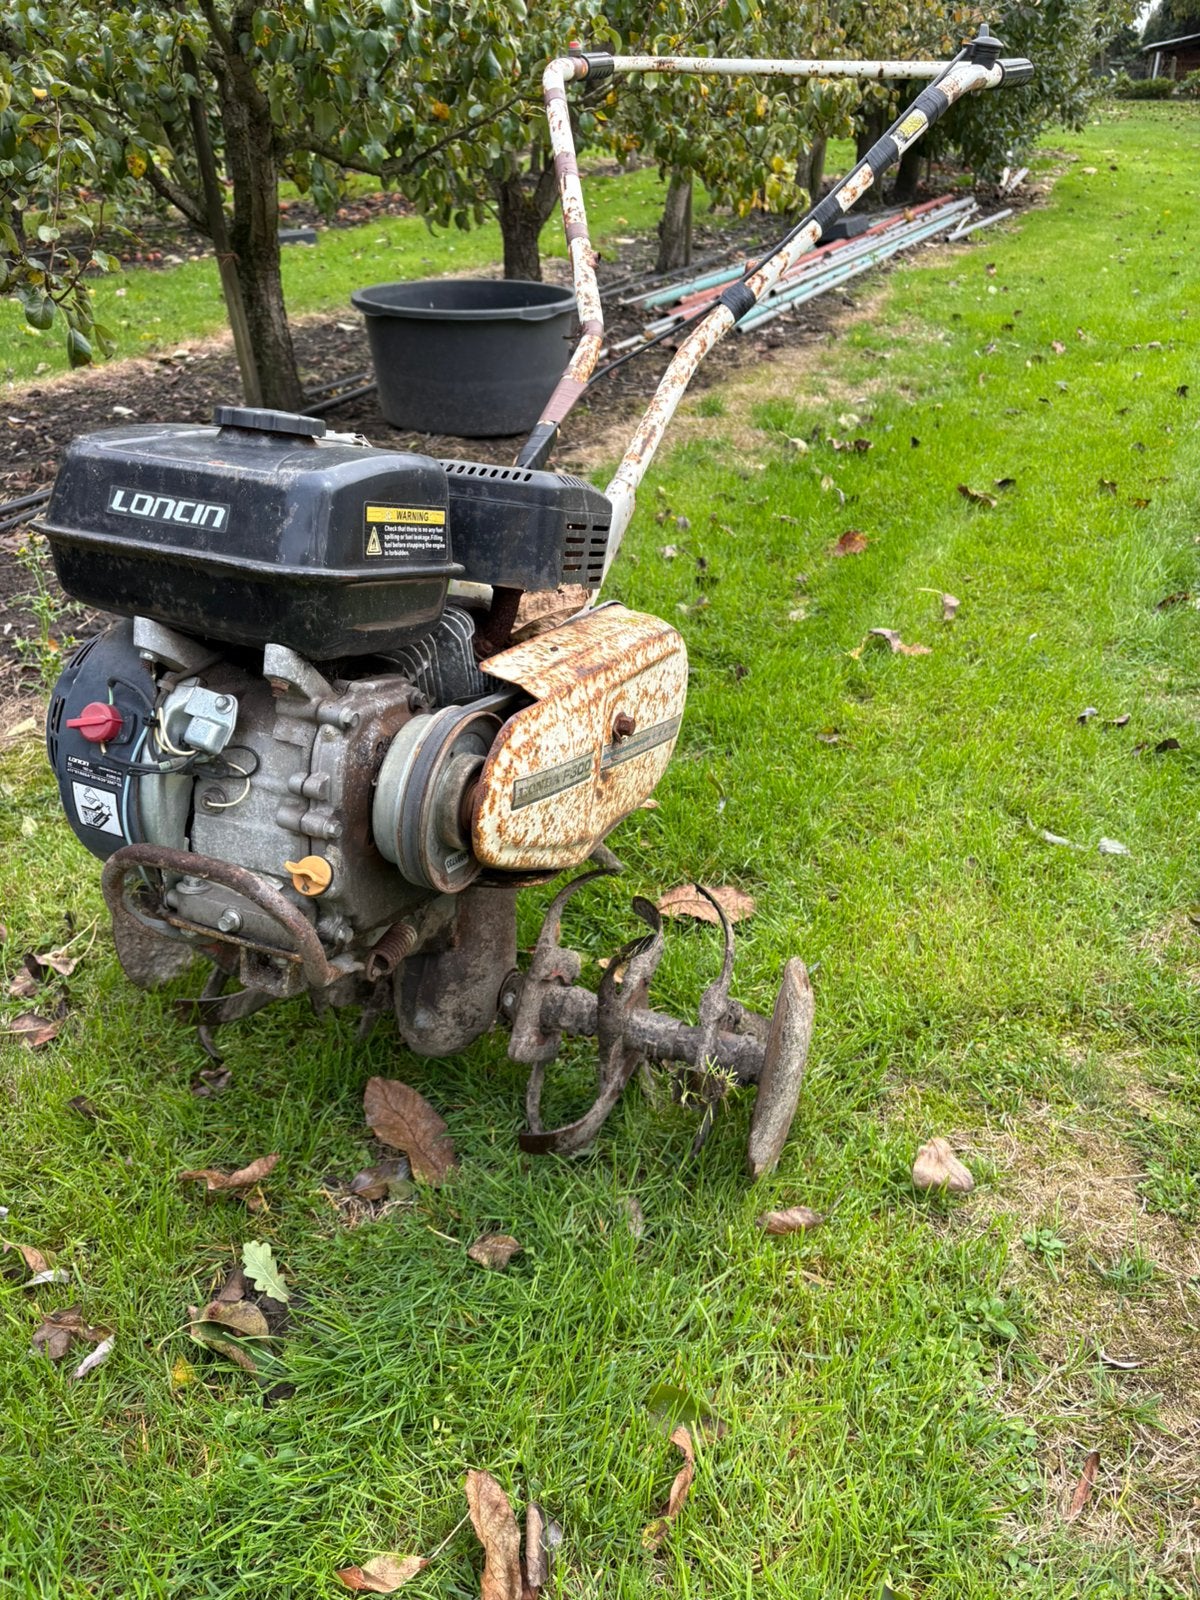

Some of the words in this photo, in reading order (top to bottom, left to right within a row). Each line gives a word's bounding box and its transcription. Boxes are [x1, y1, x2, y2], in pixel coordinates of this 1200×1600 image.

[111, 490, 226, 528] LONCIN
[396, 511, 429, 521] WARNING
[563, 759, 592, 782] F300
